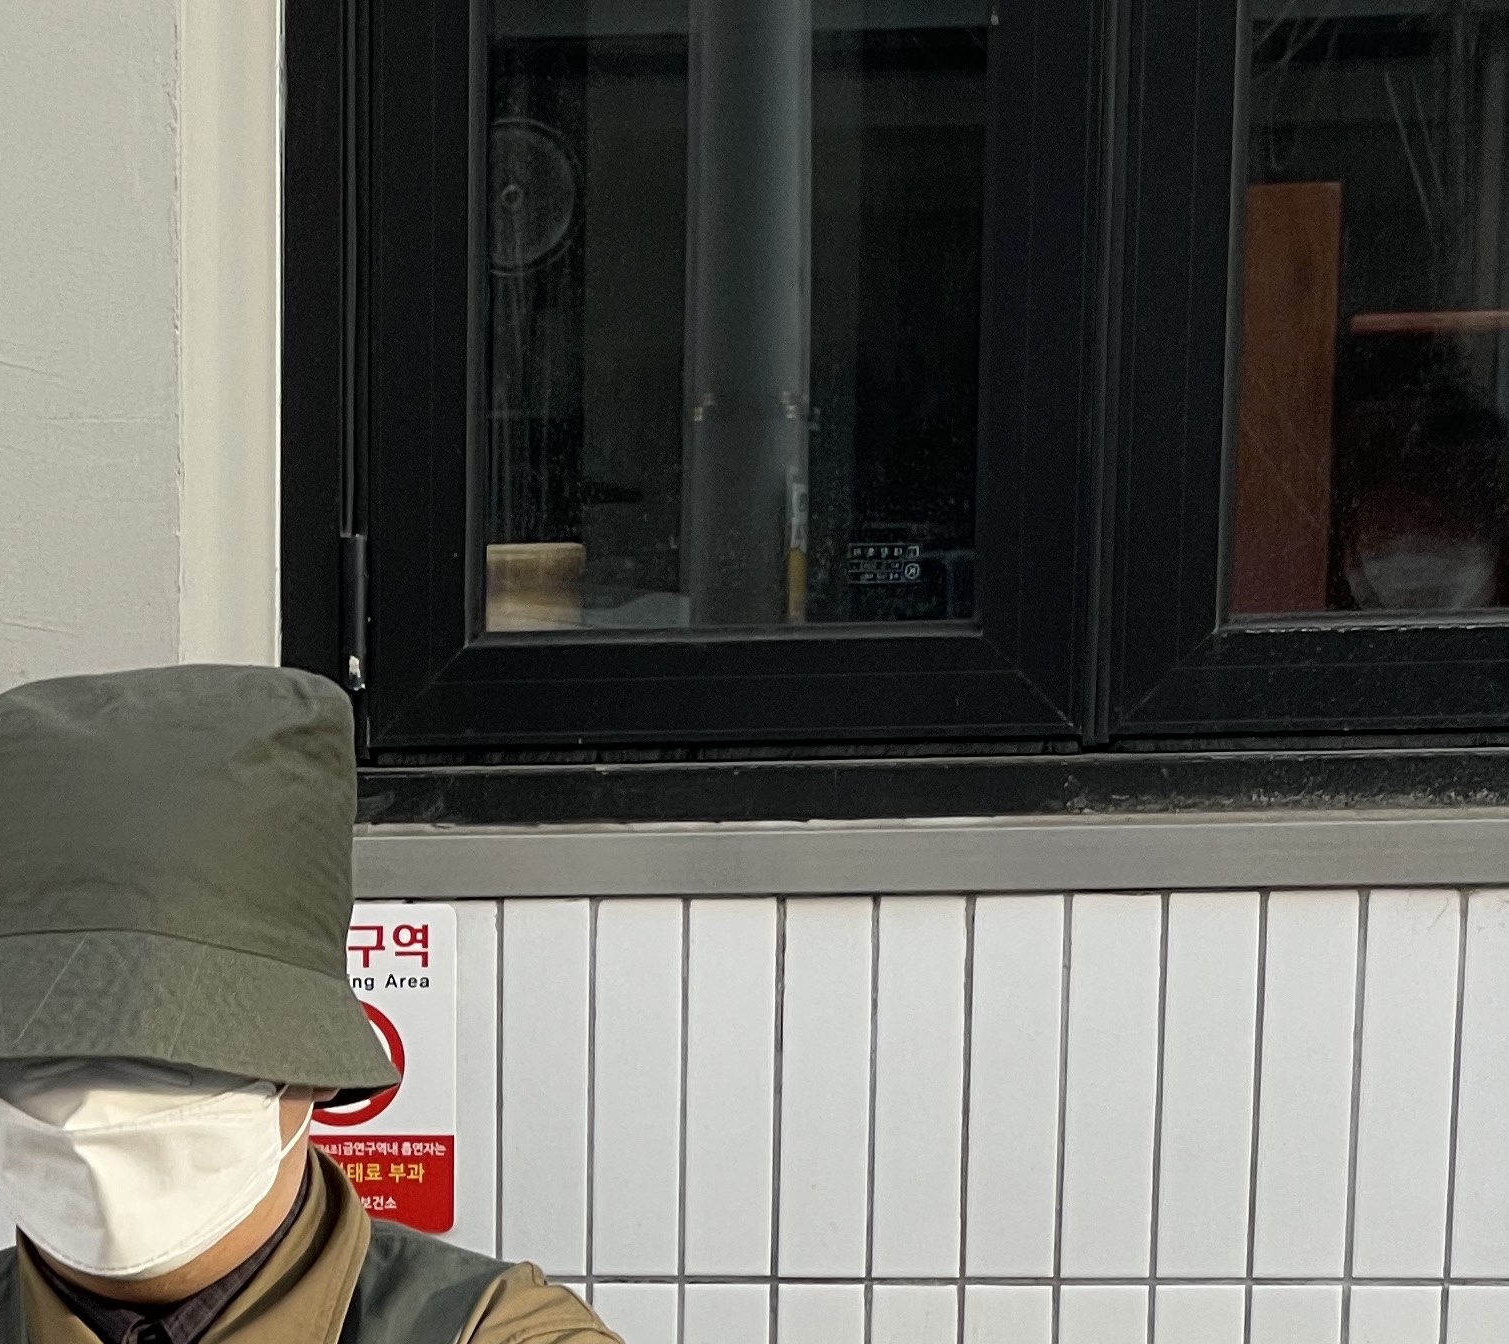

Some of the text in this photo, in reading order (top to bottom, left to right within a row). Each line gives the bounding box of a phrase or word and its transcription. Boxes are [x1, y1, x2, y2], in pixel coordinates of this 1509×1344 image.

[348, 924, 429, 968] 구역
[349, 974, 430, 991] ng Area
[401, 1141, 447, 1156] 흡연자는
[340, 1162, 425, 1184] 태료 부과
[361, 1195, 397, 1211] 보건소
